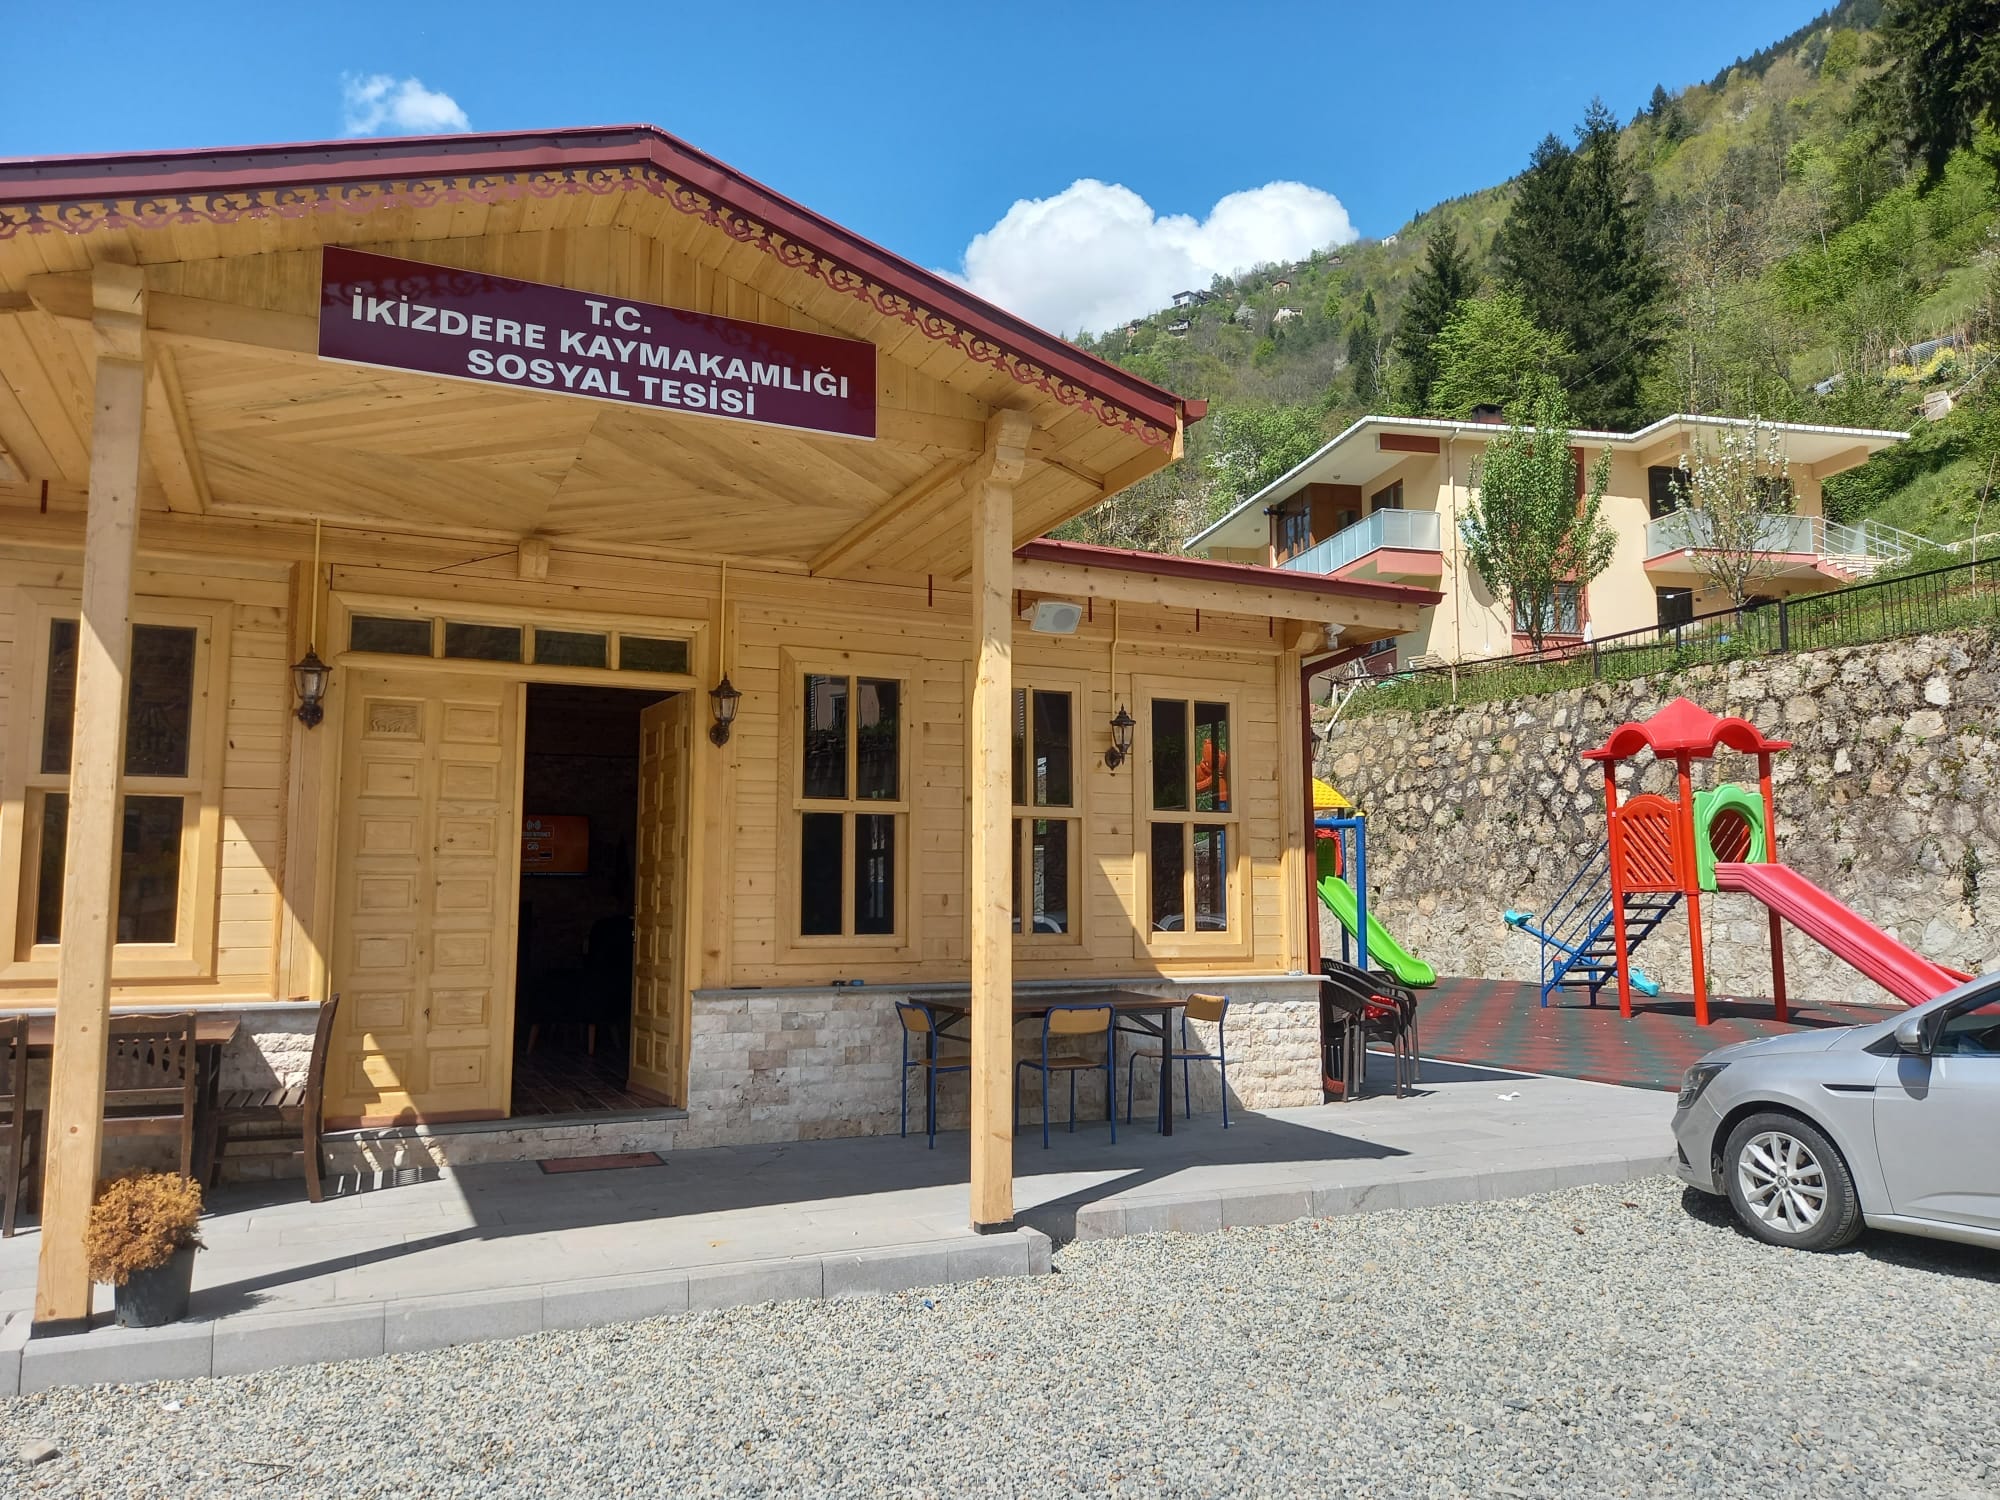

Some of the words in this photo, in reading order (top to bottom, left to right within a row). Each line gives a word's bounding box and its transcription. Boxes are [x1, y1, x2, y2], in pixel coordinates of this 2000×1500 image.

[353, 287, 546, 350] İKİZDERE
[560, 329, 849, 399] KAYMAKAMLIĞI
[585, 299, 652, 334] T.C.
[467, 349, 632, 397] SOSYAL
[637, 375, 755, 415] TESİSİ
